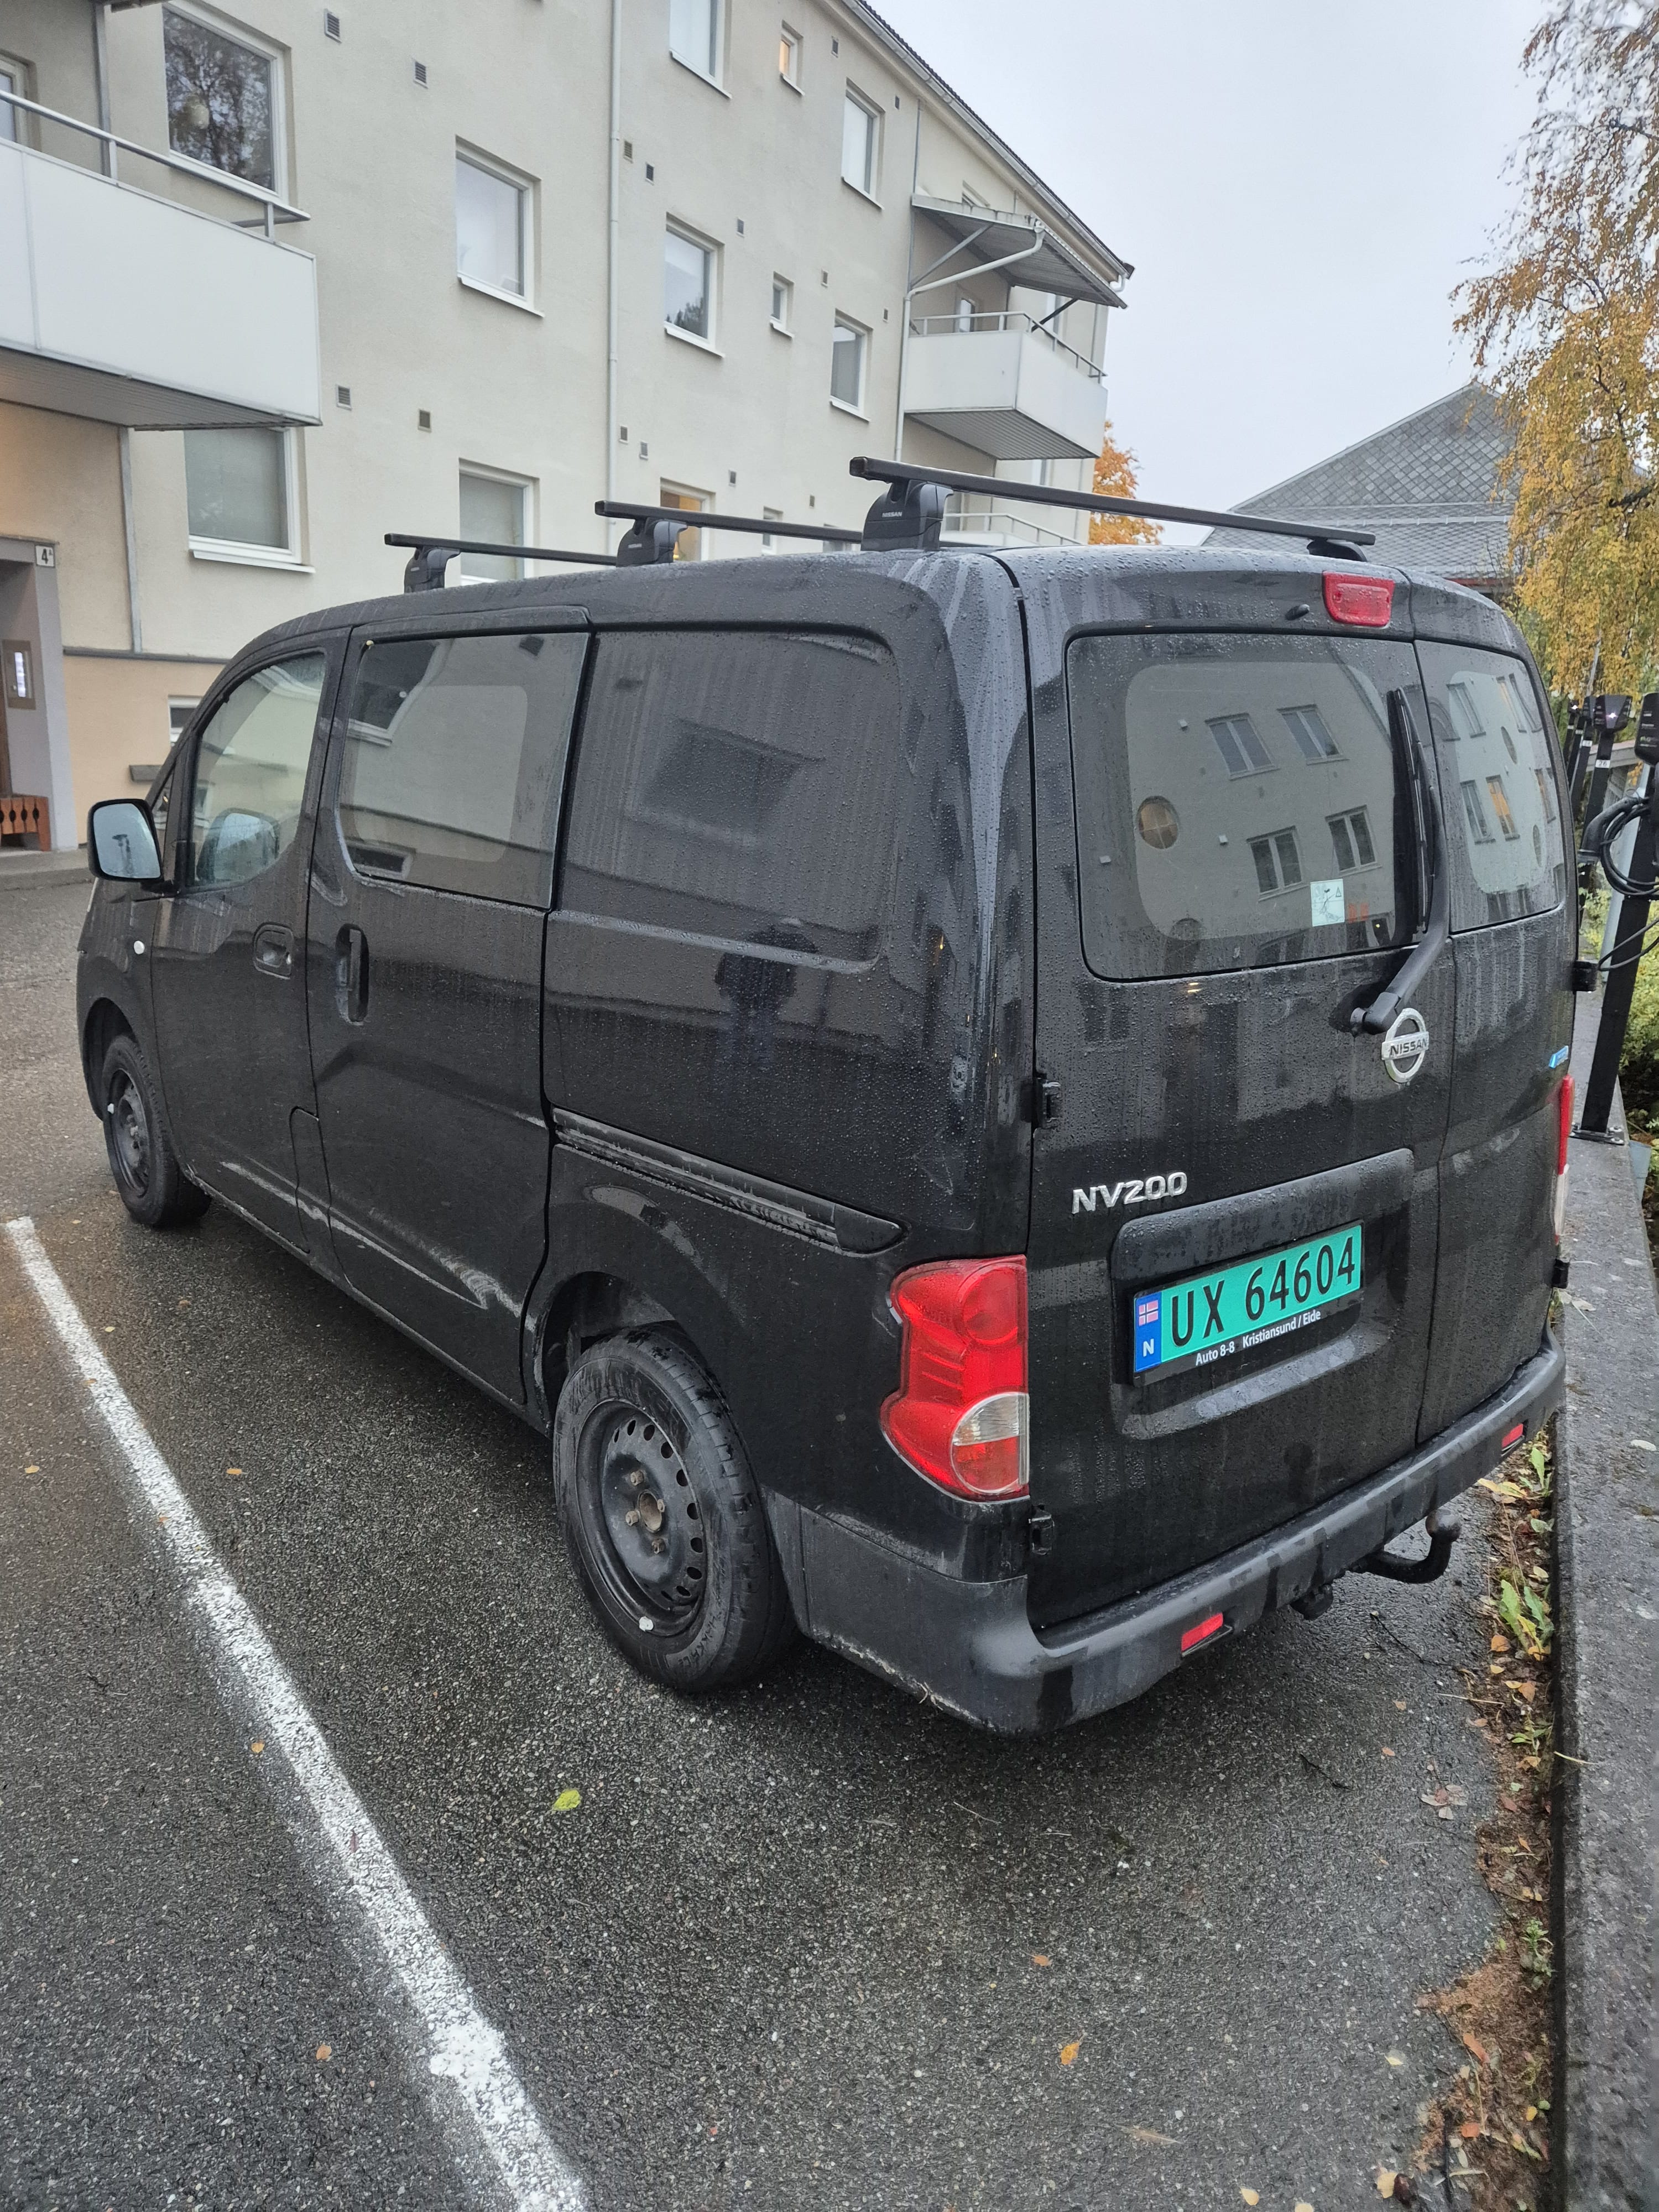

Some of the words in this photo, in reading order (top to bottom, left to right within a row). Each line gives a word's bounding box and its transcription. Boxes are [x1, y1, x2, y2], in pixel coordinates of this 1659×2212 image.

[1390, 1038, 1427, 1056] NISSAN
[1072, 1172, 1187, 1214] NV200
[1171, 1280, 1225, 1347] UX
[1244, 1235, 1356, 1321] 64604
[1142, 1338, 1155, 1357] N
[1195, 1349, 1219, 1366] Auto
[1219, 1340, 1235, 1357] 8-8
[1242, 1316, 1297, 1349] Kristiansund
[1302, 1308, 1322, 1326] Eide
